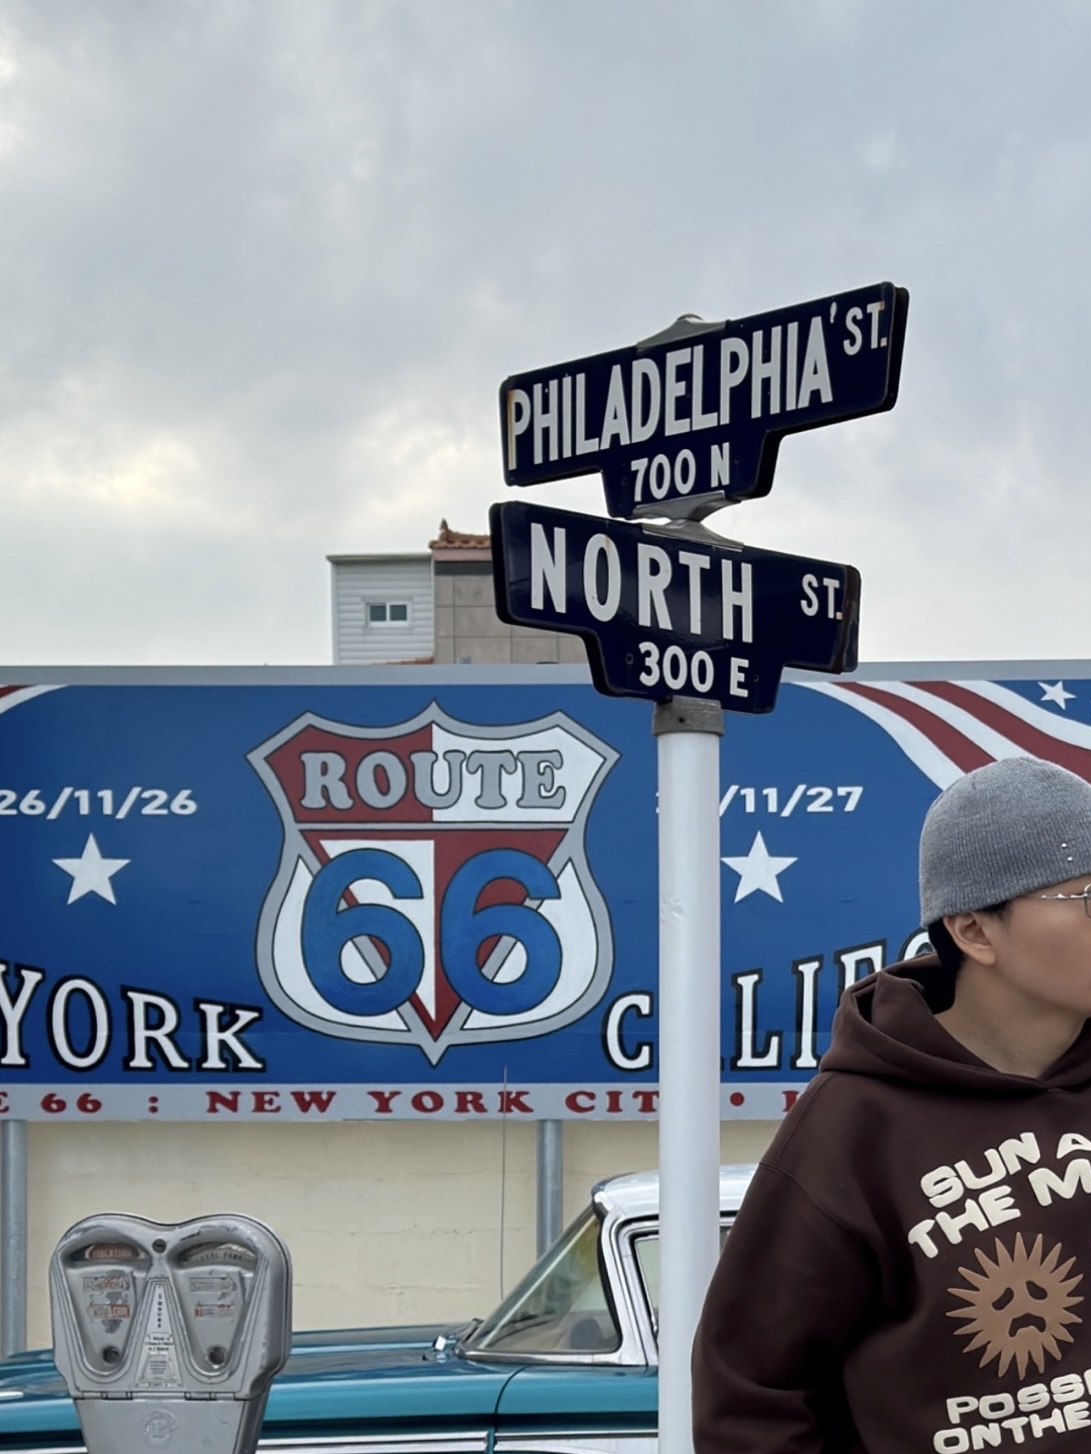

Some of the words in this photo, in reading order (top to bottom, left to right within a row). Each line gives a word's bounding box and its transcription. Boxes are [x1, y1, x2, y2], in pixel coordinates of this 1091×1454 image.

[842, 301, 887, 355] ST.
[631, 448, 696, 501] 700
[710, 442, 730, 488] N
[530, 523, 753, 643] NORTH
[800, 573, 843, 620] ST.
[639, 642, 714, 693] 300
[730, 657, 749, 697] E
[0, 786, 198, 820] 26/11/26
[300, 750, 566, 811] ROUTE
[655, 784, 864, 818] /11/27
[302, 847, 563, 1016] 66
[0, 963, 263, 1073] YORK
[41, 1092, 102, 1113] 66
[206, 1091, 337, 1113] NEW
[367, 1091, 534, 1113] YORK
[565, 1091, 660, 1113] CIT
[920, 1132, 1041, 1208] SUN
[908, 1185, 1021, 1258] THE
